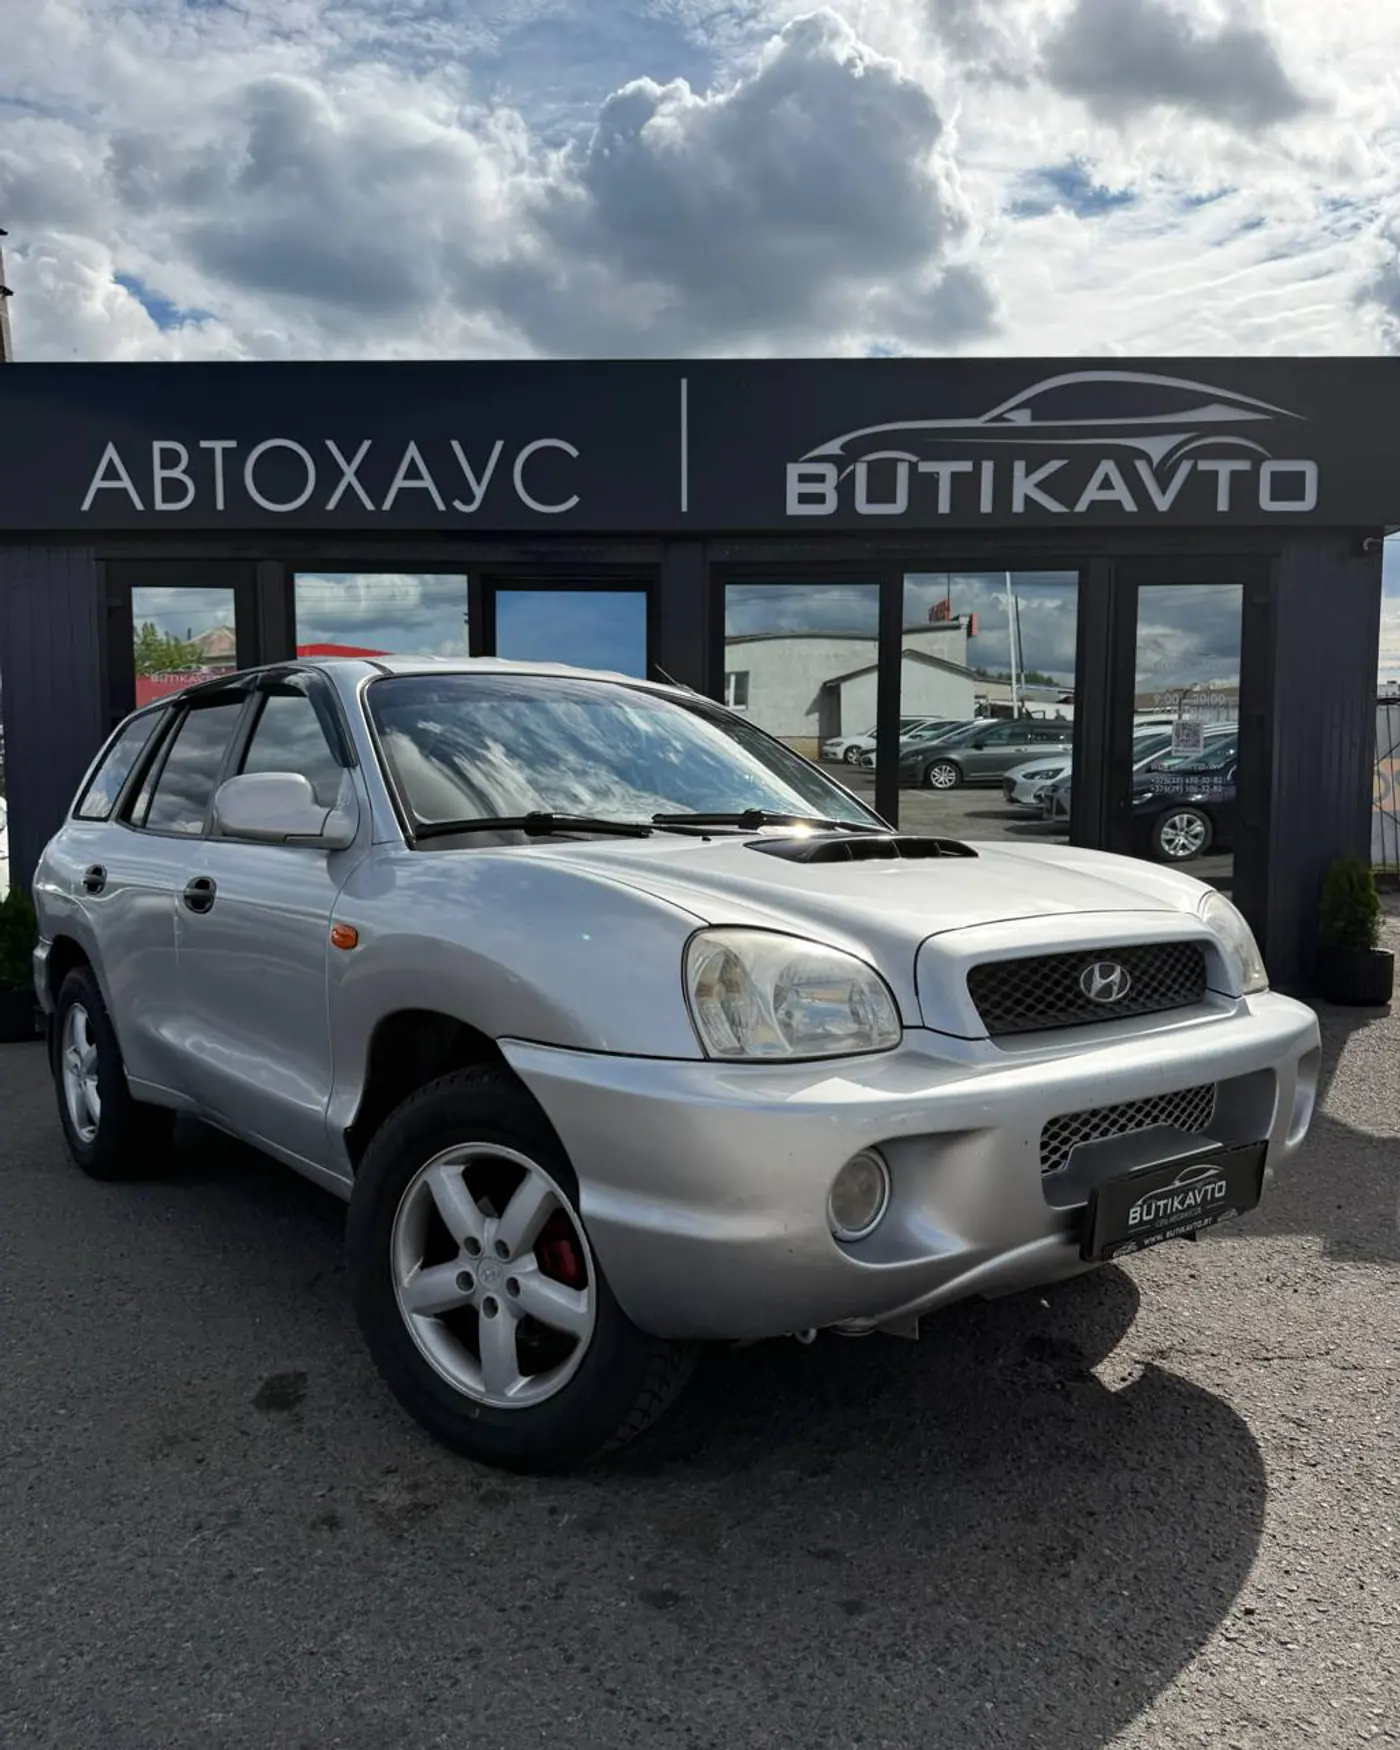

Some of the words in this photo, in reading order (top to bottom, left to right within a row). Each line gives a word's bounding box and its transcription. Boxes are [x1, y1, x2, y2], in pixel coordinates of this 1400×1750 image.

[81, 437, 580, 515] АВТОХАУС
[786, 459, 1319, 516] BUTIKAVTO
[1128, 1181, 1226, 1225] BUTIKAVTO
